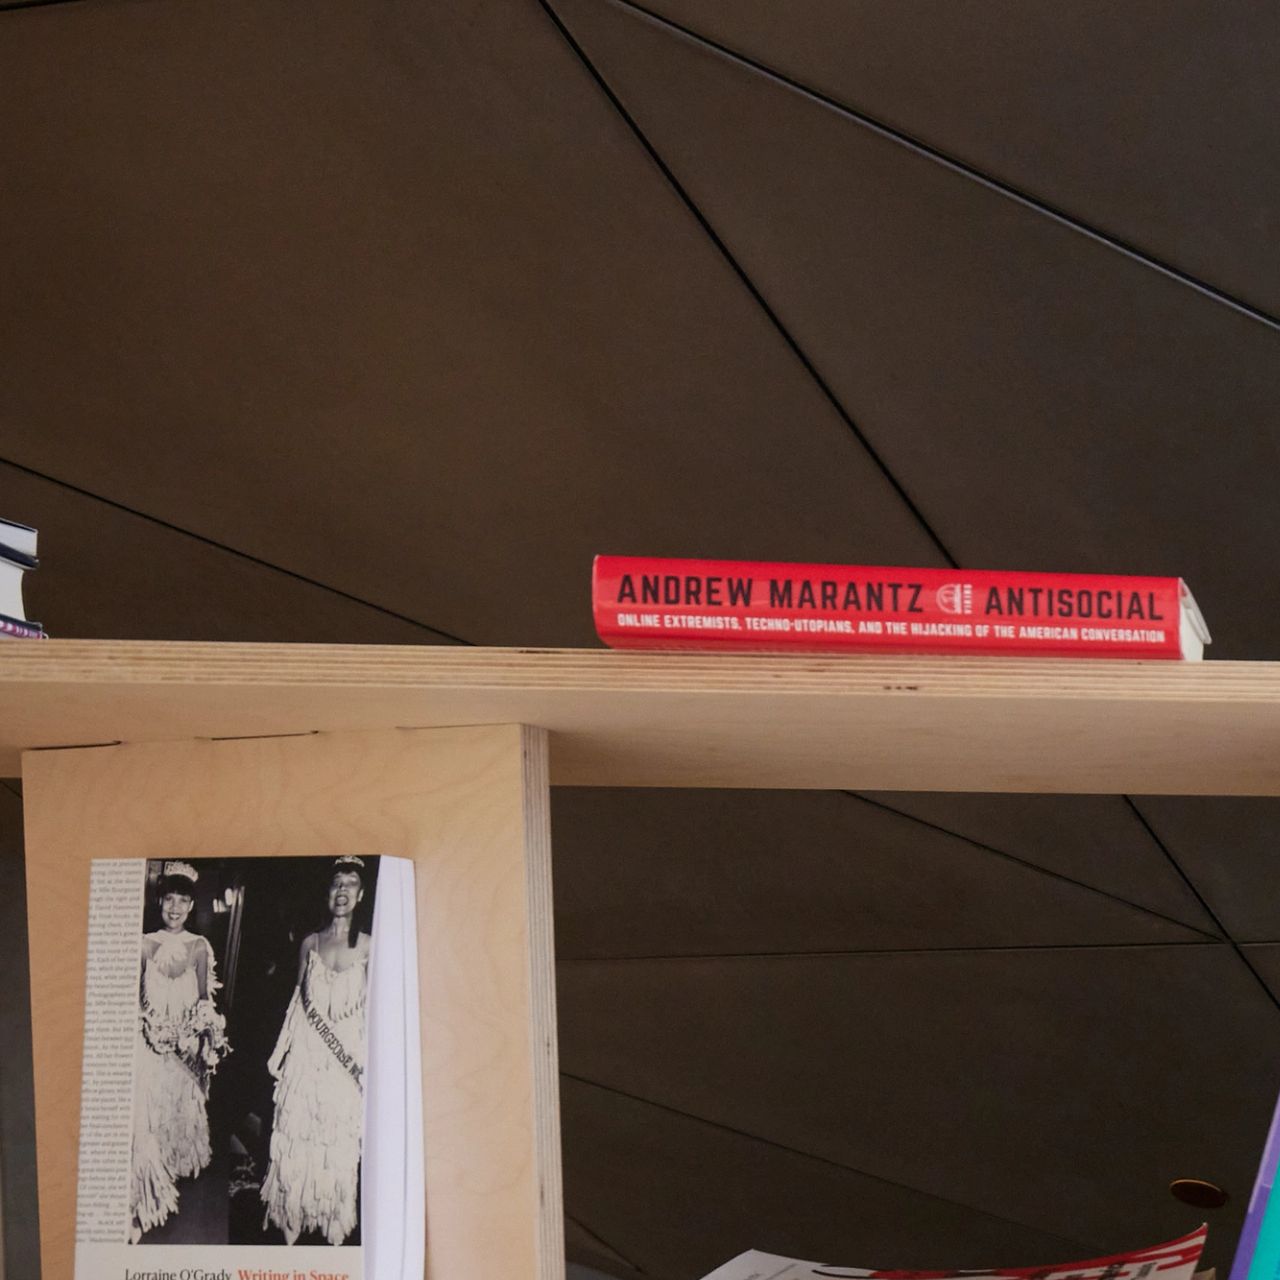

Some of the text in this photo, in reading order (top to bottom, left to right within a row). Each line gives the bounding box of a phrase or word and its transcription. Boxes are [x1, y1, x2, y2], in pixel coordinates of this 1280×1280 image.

[617, 575, 753, 607] ANDREW
[769, 579, 923, 613] MARANTZ
[985, 586, 1163, 621] ANTISOCIAL
[618, 613, 660, 627] ONLINE
[858, 621, 883, 634] AND
[886, 622, 906, 635] THE
[911, 623, 973, 637] HIJACKING
[975, 624, 989, 637] OF
[994, 625, 1015, 638] THE
[1018, 626, 1078, 640] AMERICAN
[1081, 628, 1165, 643] CONVERSATION
